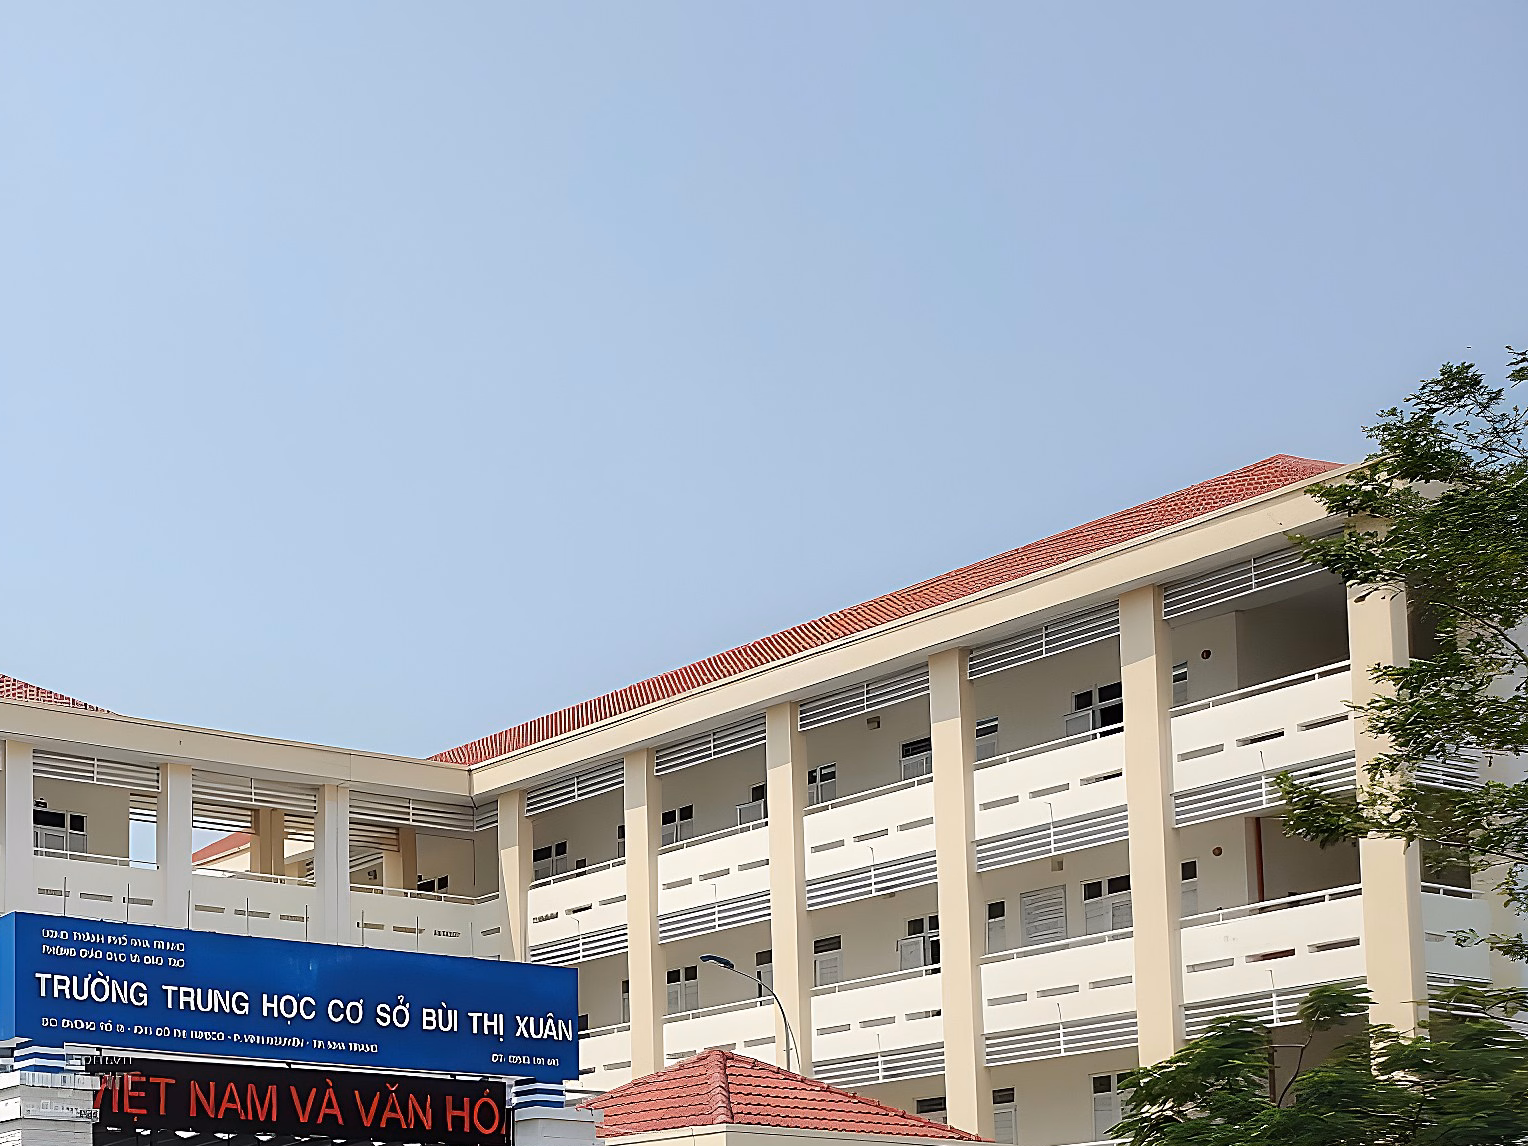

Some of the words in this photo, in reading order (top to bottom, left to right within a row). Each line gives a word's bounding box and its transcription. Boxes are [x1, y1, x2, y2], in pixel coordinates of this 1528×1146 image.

[34, 970, 148, 1007] TRƯỜNG
[161, 984, 250, 1015] TRUNG
[261, 993, 316, 1025] HỌC
[327, 998, 364, 1024] CƠ
[375, 995, 410, 1028] SỞ
[422, 1002, 459, 1032] BÙI
[467, 1012, 504, 1042] THỊ
[515, 1012, 573, 1042] XUÂN
[188, 1079, 278, 1122] NAM
[289, 1078, 345, 1125] VÀ
[353, 1083, 433, 1131] VĂN
[445, 1088, 506, 1135] HÓ
